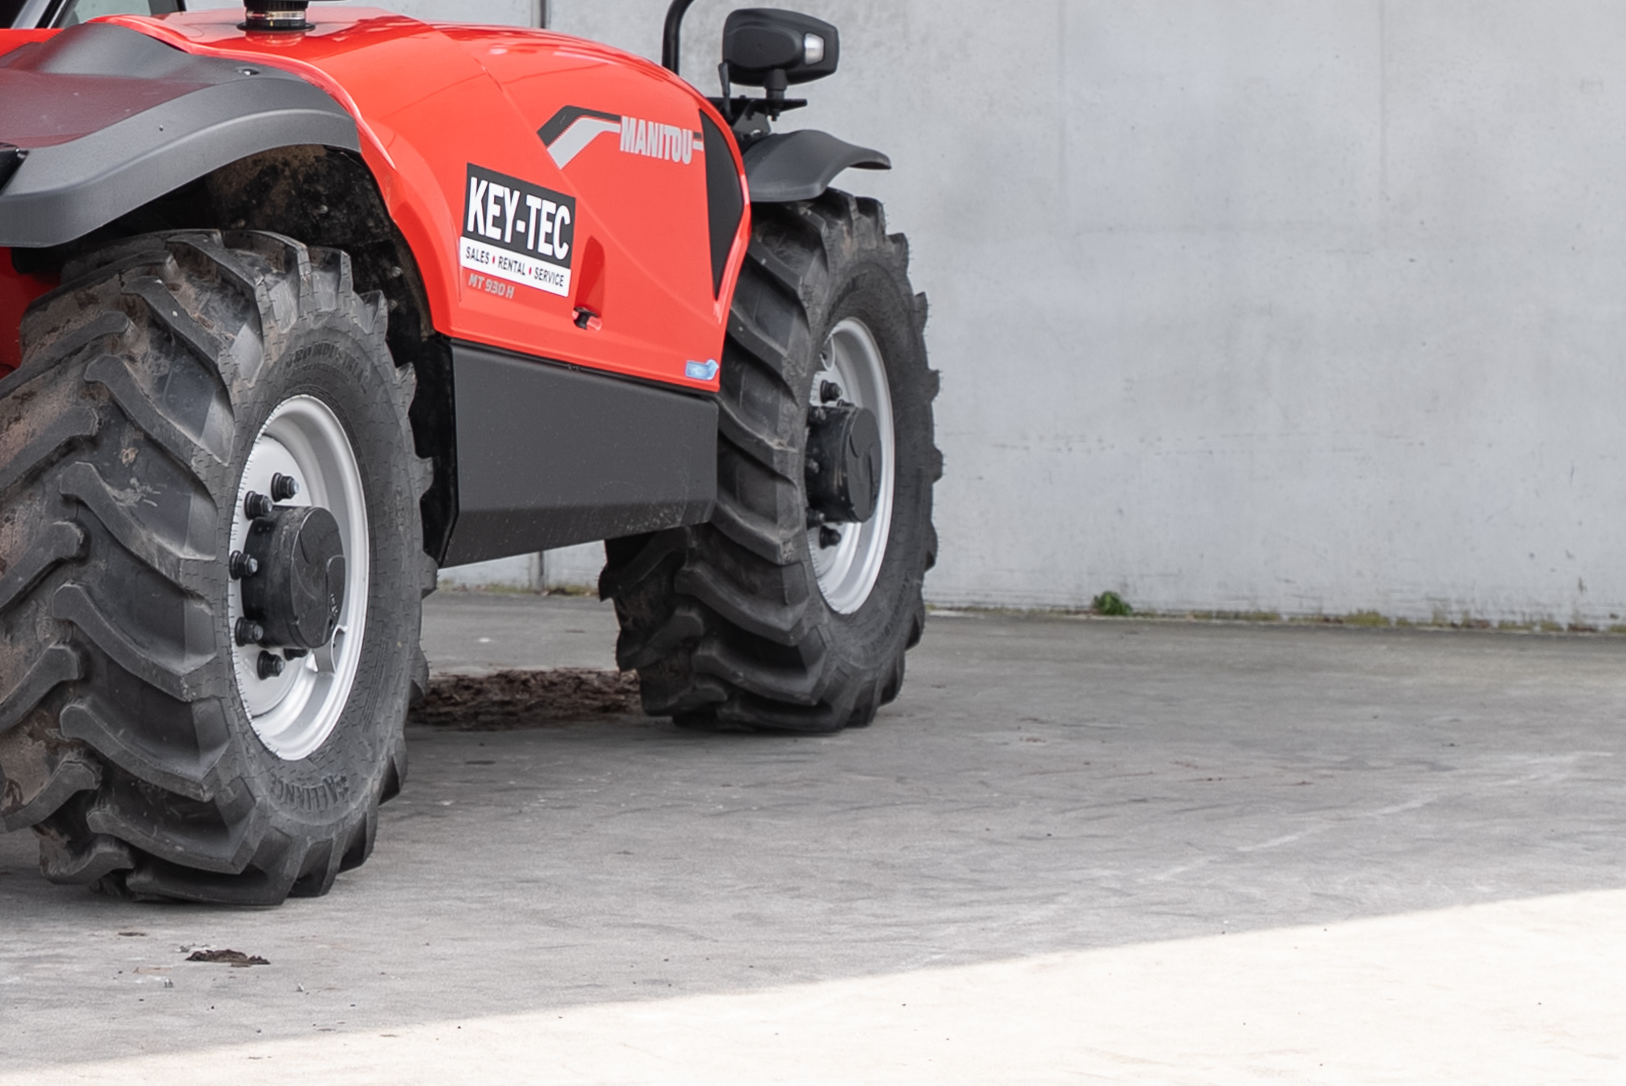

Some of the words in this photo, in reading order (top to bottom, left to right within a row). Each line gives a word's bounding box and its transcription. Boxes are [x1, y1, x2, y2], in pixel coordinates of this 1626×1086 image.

[619, 115, 694, 165] MANITOU
[466, 176, 571, 260] KEY-TEC
[466, 246, 490, 264] SALES
[498, 255, 526, 276] RENTAL
[534, 267, 564, 287] SERVICE
[468, 273, 483, 289] MT
[485, 279, 504, 296] 930
[505, 285, 515, 299] H
